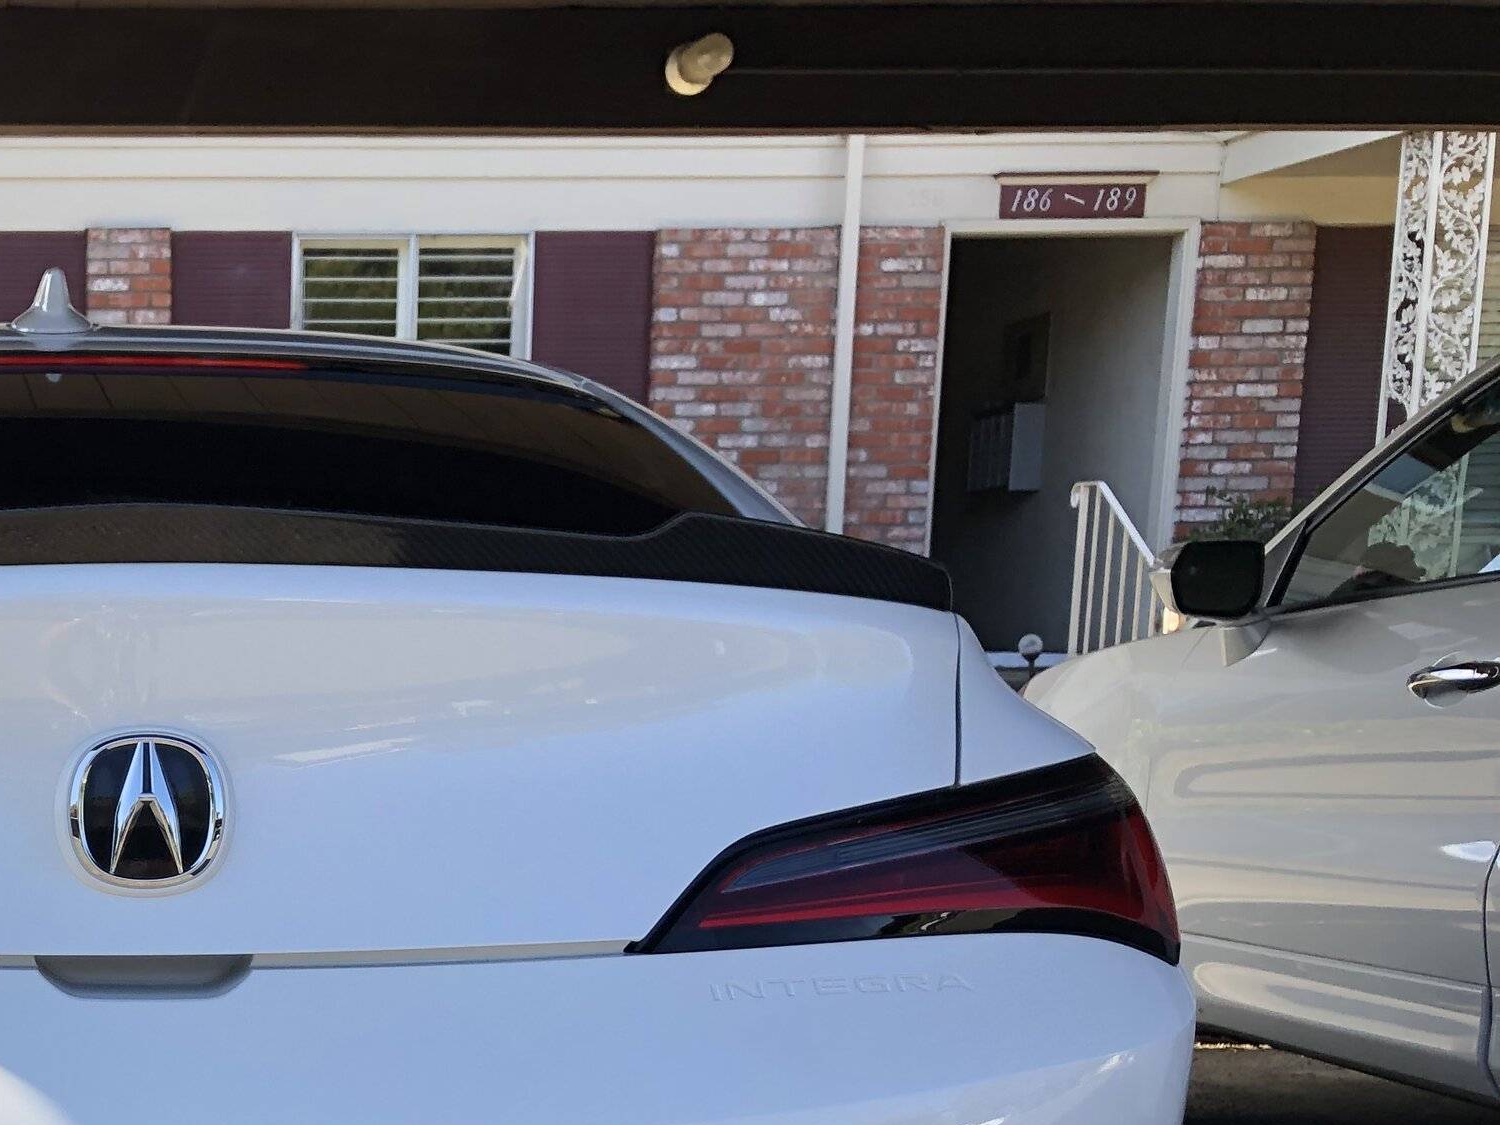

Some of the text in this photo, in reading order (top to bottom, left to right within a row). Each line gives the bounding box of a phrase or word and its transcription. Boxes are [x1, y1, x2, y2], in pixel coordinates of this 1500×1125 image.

[1011, 188, 1053, 212] 186
[1093, 187, 1137, 211] 189
[709, 974, 974, 1001] INTEGRA
